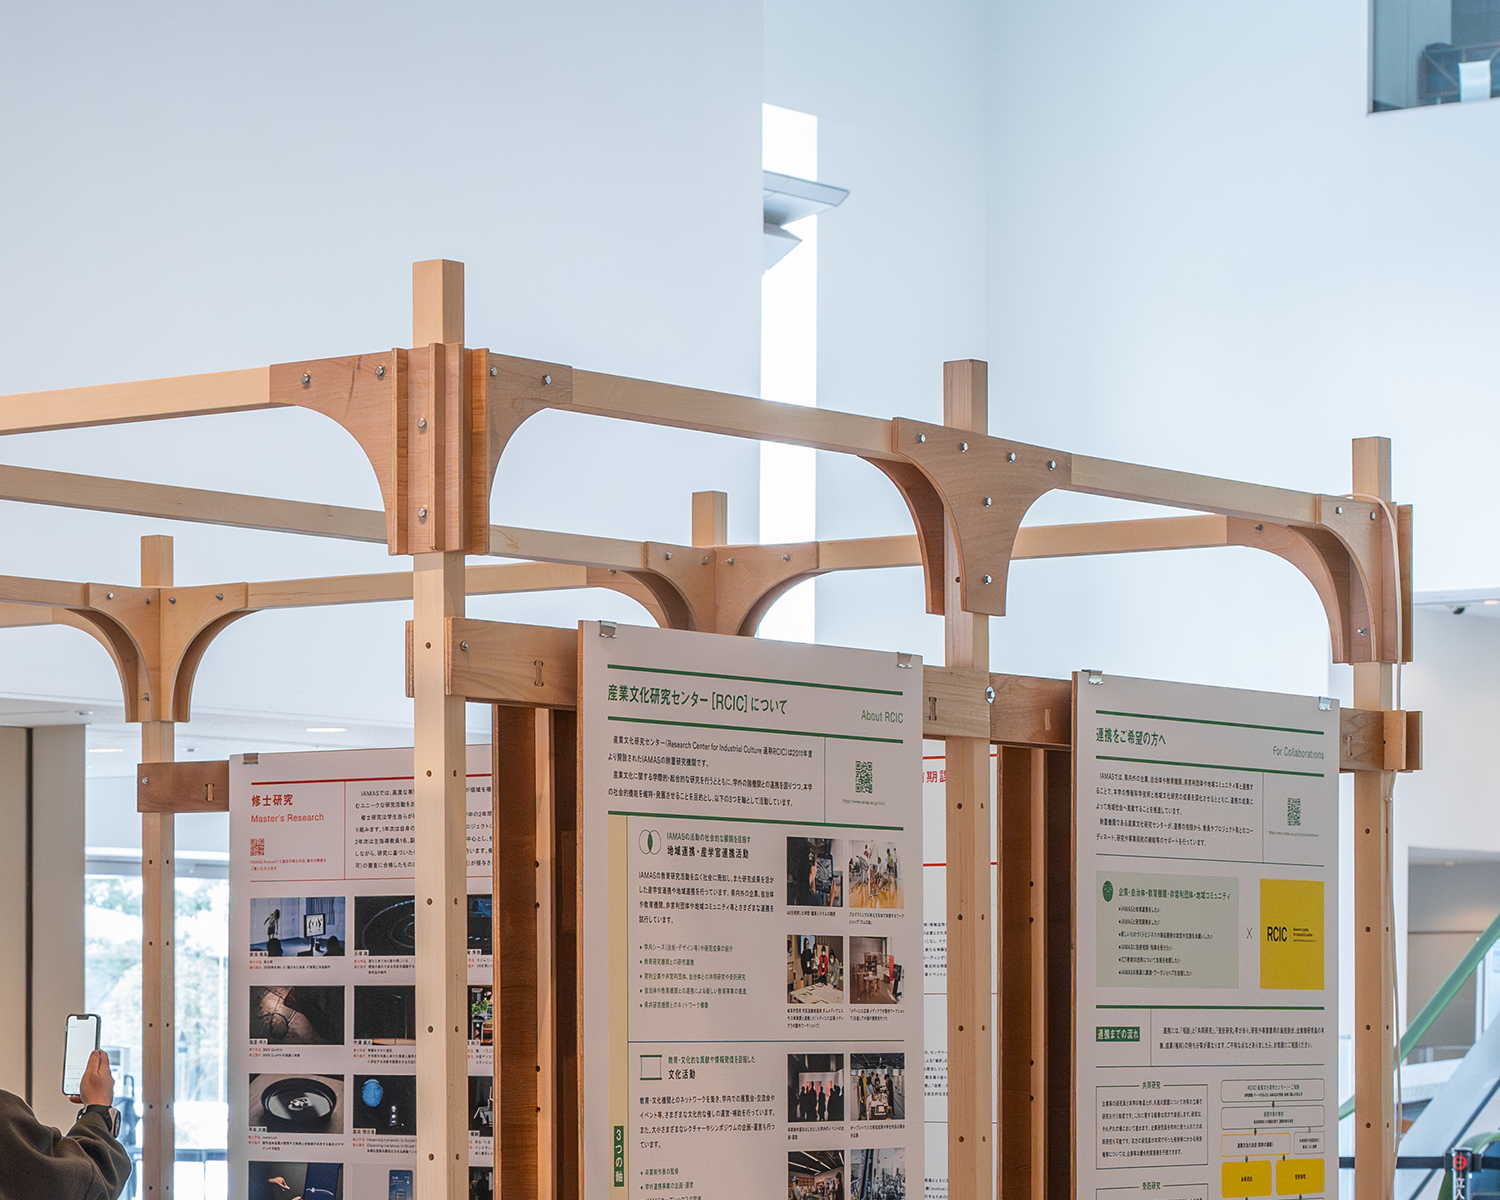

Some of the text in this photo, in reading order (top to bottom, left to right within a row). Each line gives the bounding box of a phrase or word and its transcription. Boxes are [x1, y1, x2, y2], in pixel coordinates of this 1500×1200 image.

[608, 684, 788, 714] 産業文化研究センター [RCIC] について
[861, 710, 903, 723] About RCIC
[1096, 727, 1166, 746] 連携をご希望の方へ
[692, 741, 710, 751] Center
[1273, 746, 1324, 760] For Collaborations
[251, 794, 293, 806] 修士研究
[251, 813, 324, 823] Master's Research
[667, 845, 749, 859] 地域連携・産学官連携活動
[1267, 926, 1287, 942] RCIC
[668, 1069, 696, 1080] 文化活動
[640, 1141, 661, 1149] ています。
[615, 1129, 623, 1183] 3つの軸
